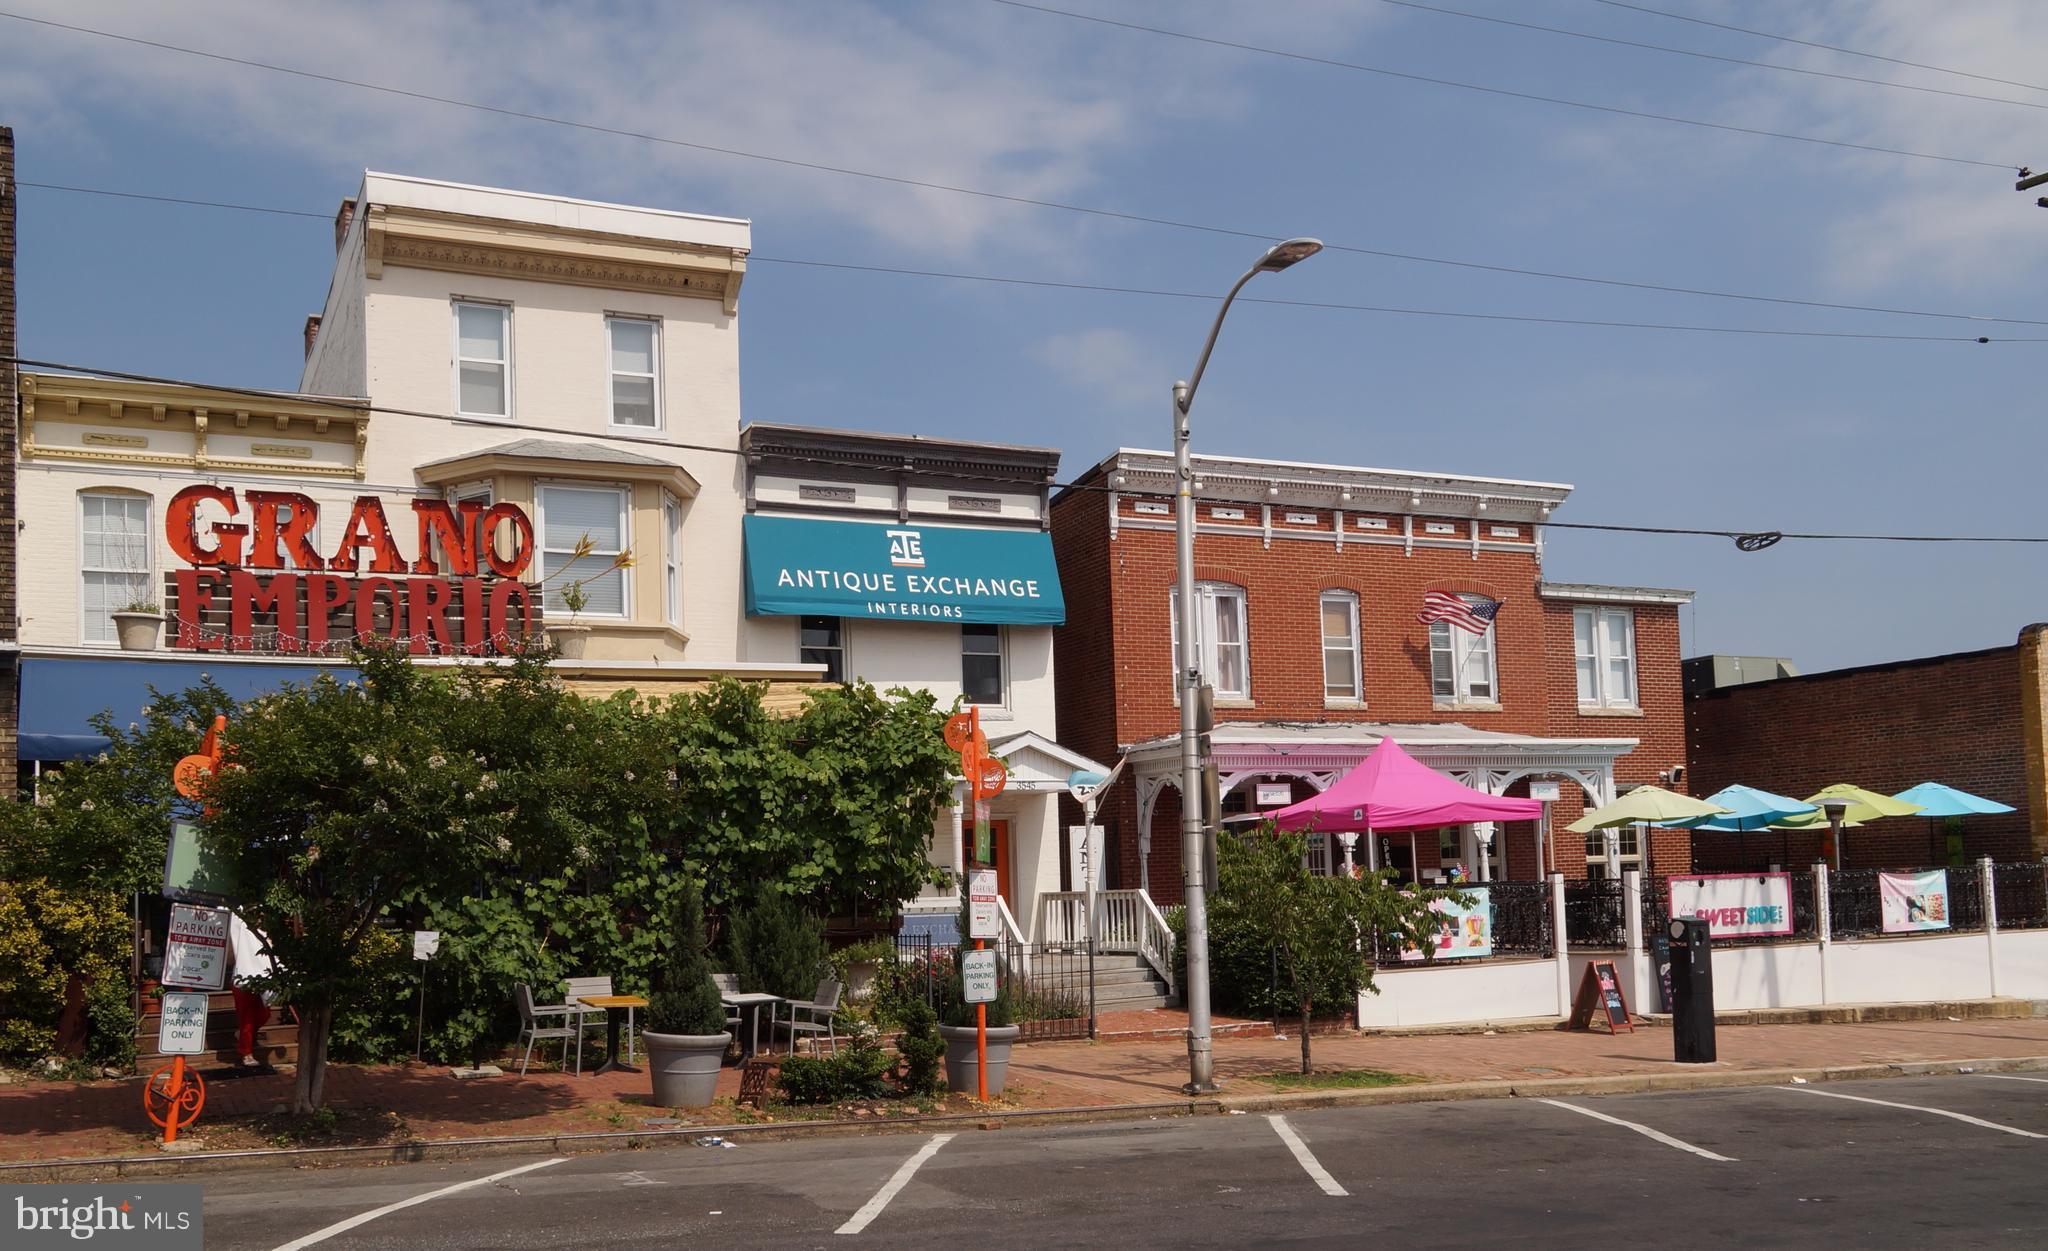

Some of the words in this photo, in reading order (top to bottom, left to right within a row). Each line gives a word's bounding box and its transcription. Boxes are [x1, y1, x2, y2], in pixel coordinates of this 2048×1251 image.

[166, 484, 534, 577] GRANO
[778, 568, 897, 593] ANTIQUE
[907, 575, 1041, 598] EXCHANGE
[174, 569, 532, 655] EMPORIO
[868, 602, 963, 618] INTERIORS
[1016, 781, 1036, 791] 3545
[194, 910, 208, 922] NO
[175, 922, 224, 937] PARKING
[190, 936, 206, 944] AWAY
[208, 938, 224, 946] ZONE
[966, 962, 994, 970] BACK-IN
[966, 972, 995, 980] PARKING
[166, 1006, 204, 1016] BACK-IN
[165, 1018, 203, 1028] PARKING
[171, 1030, 194, 1039] ONLY
